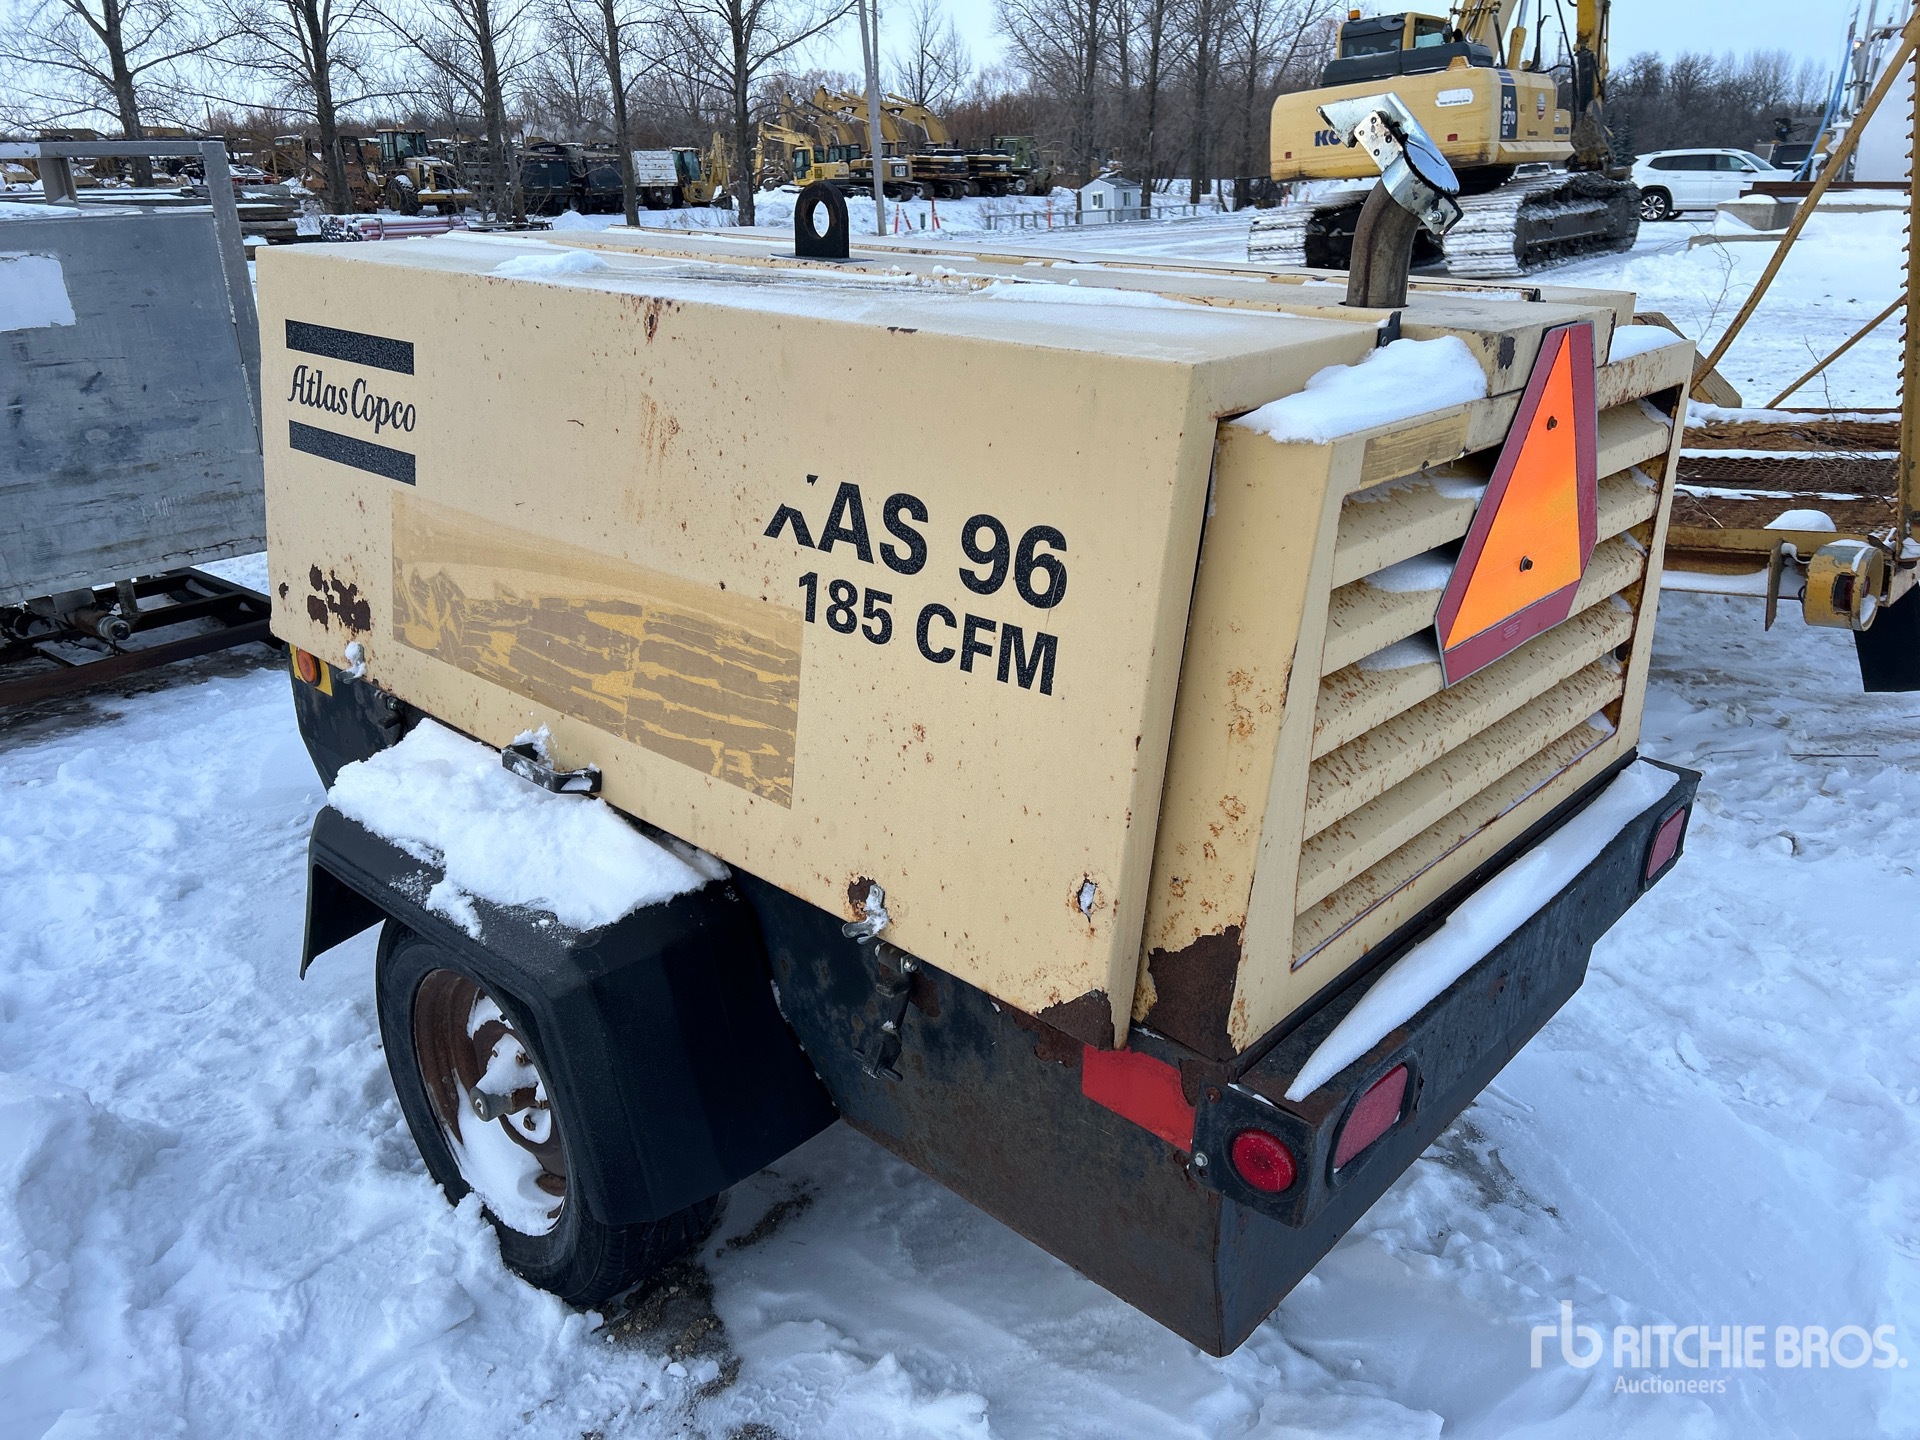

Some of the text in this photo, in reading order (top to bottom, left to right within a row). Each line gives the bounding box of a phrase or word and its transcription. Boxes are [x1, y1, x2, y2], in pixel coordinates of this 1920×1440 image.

[1502, 110, 1516, 125] 270
[287, 364, 416, 434] Atlas Copco
[958, 513, 1068, 610] 96
[798, 571, 1059, 697] 185 CFM
